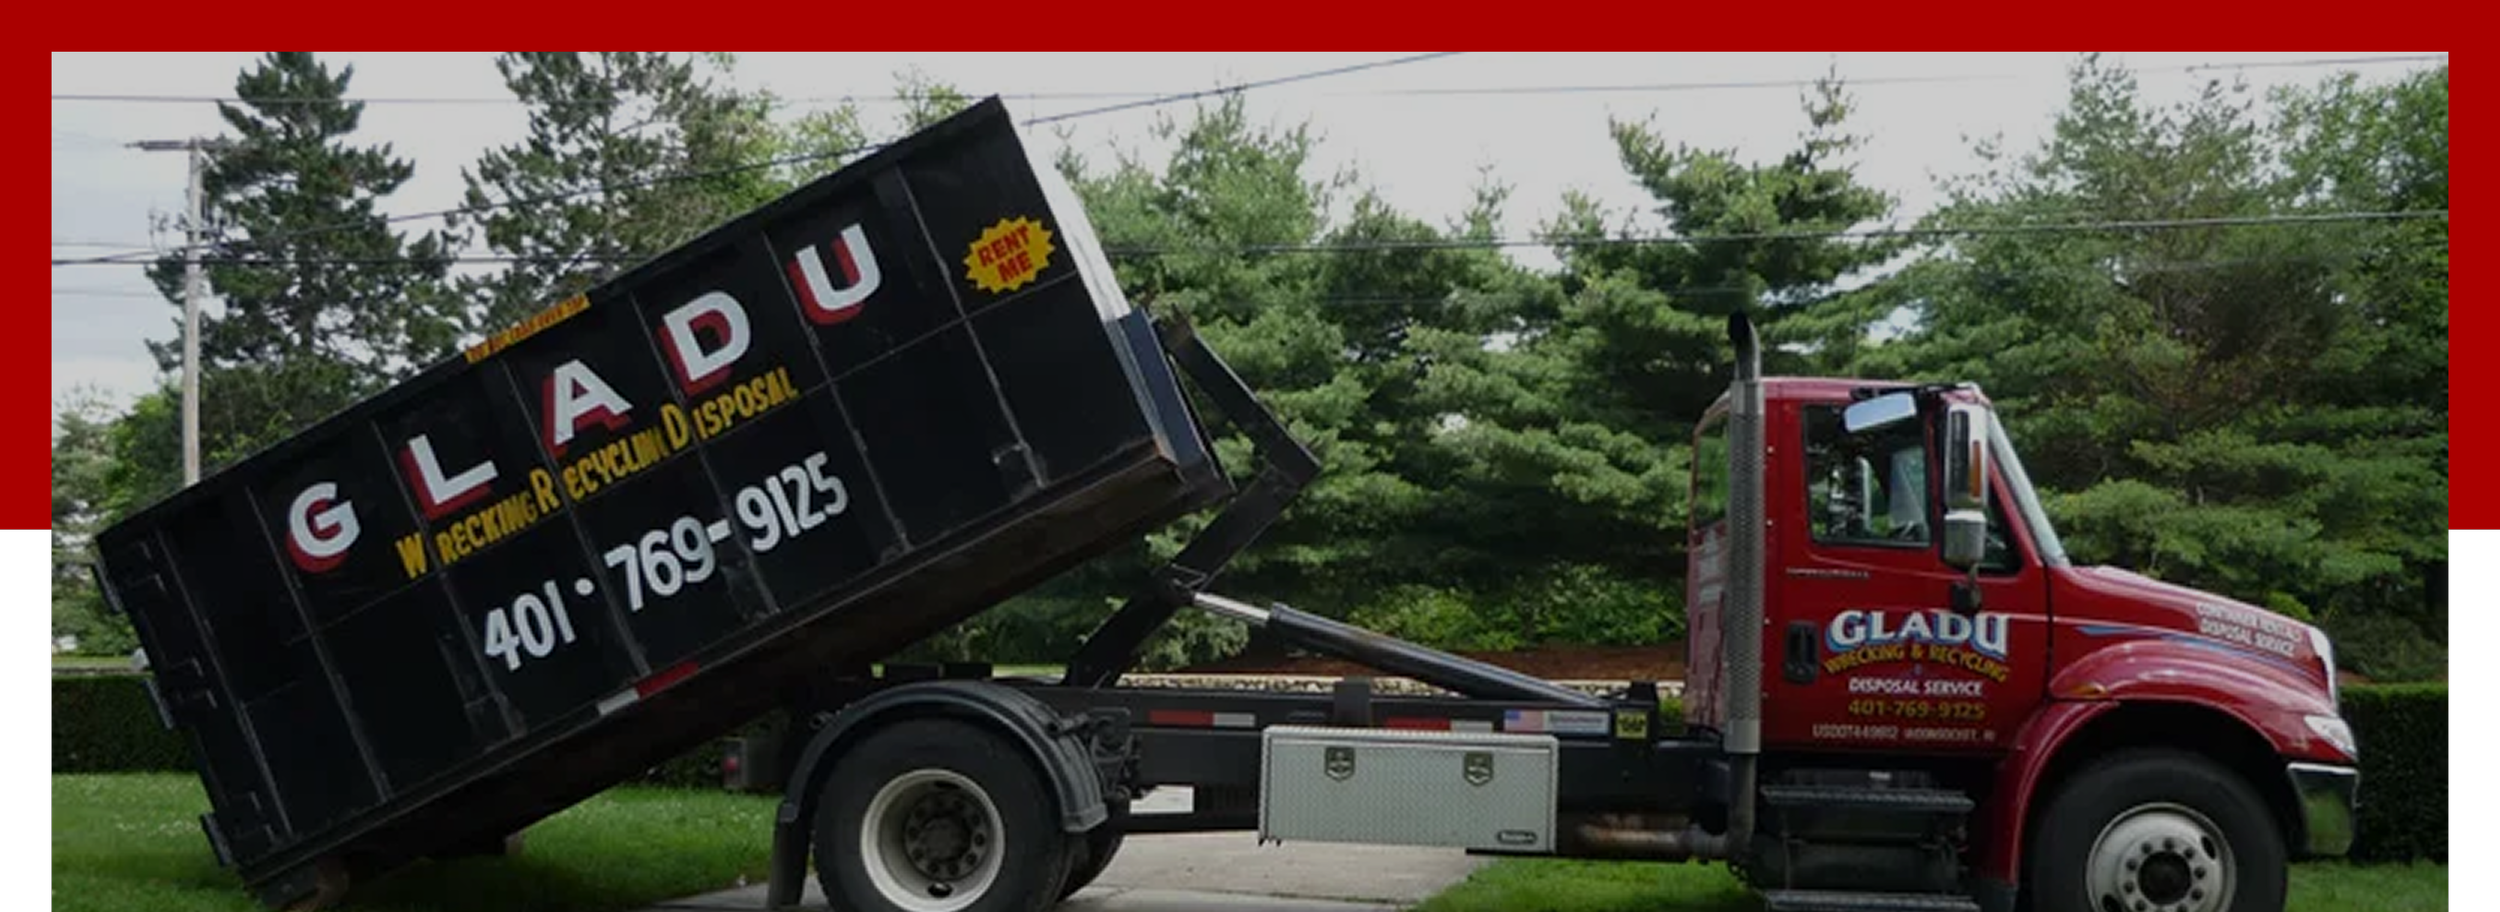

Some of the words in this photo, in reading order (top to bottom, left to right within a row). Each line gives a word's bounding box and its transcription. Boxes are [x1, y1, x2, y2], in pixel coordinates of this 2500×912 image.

[977, 224, 1030, 268] RENT
[998, 250, 1033, 282] ME
[286, 223, 882, 573] GLADU
[396, 489, 539, 579] WRECKING
[661, 366, 800, 452] DISPOSAL
[604, 451, 849, 612] 769-9125
[1827, 610, 2009, 660] GLADU
[1824, 645, 1905, 674] WRECKING
[1910, 644, 1924, 660] &
[1928, 645, 2009, 682] RECYCLING
[1848, 677, 1920, 695] DISPOSAL
[1924, 680, 1983, 696] SERVICE
[1848, 700, 1986, 719] 401-769-9125
